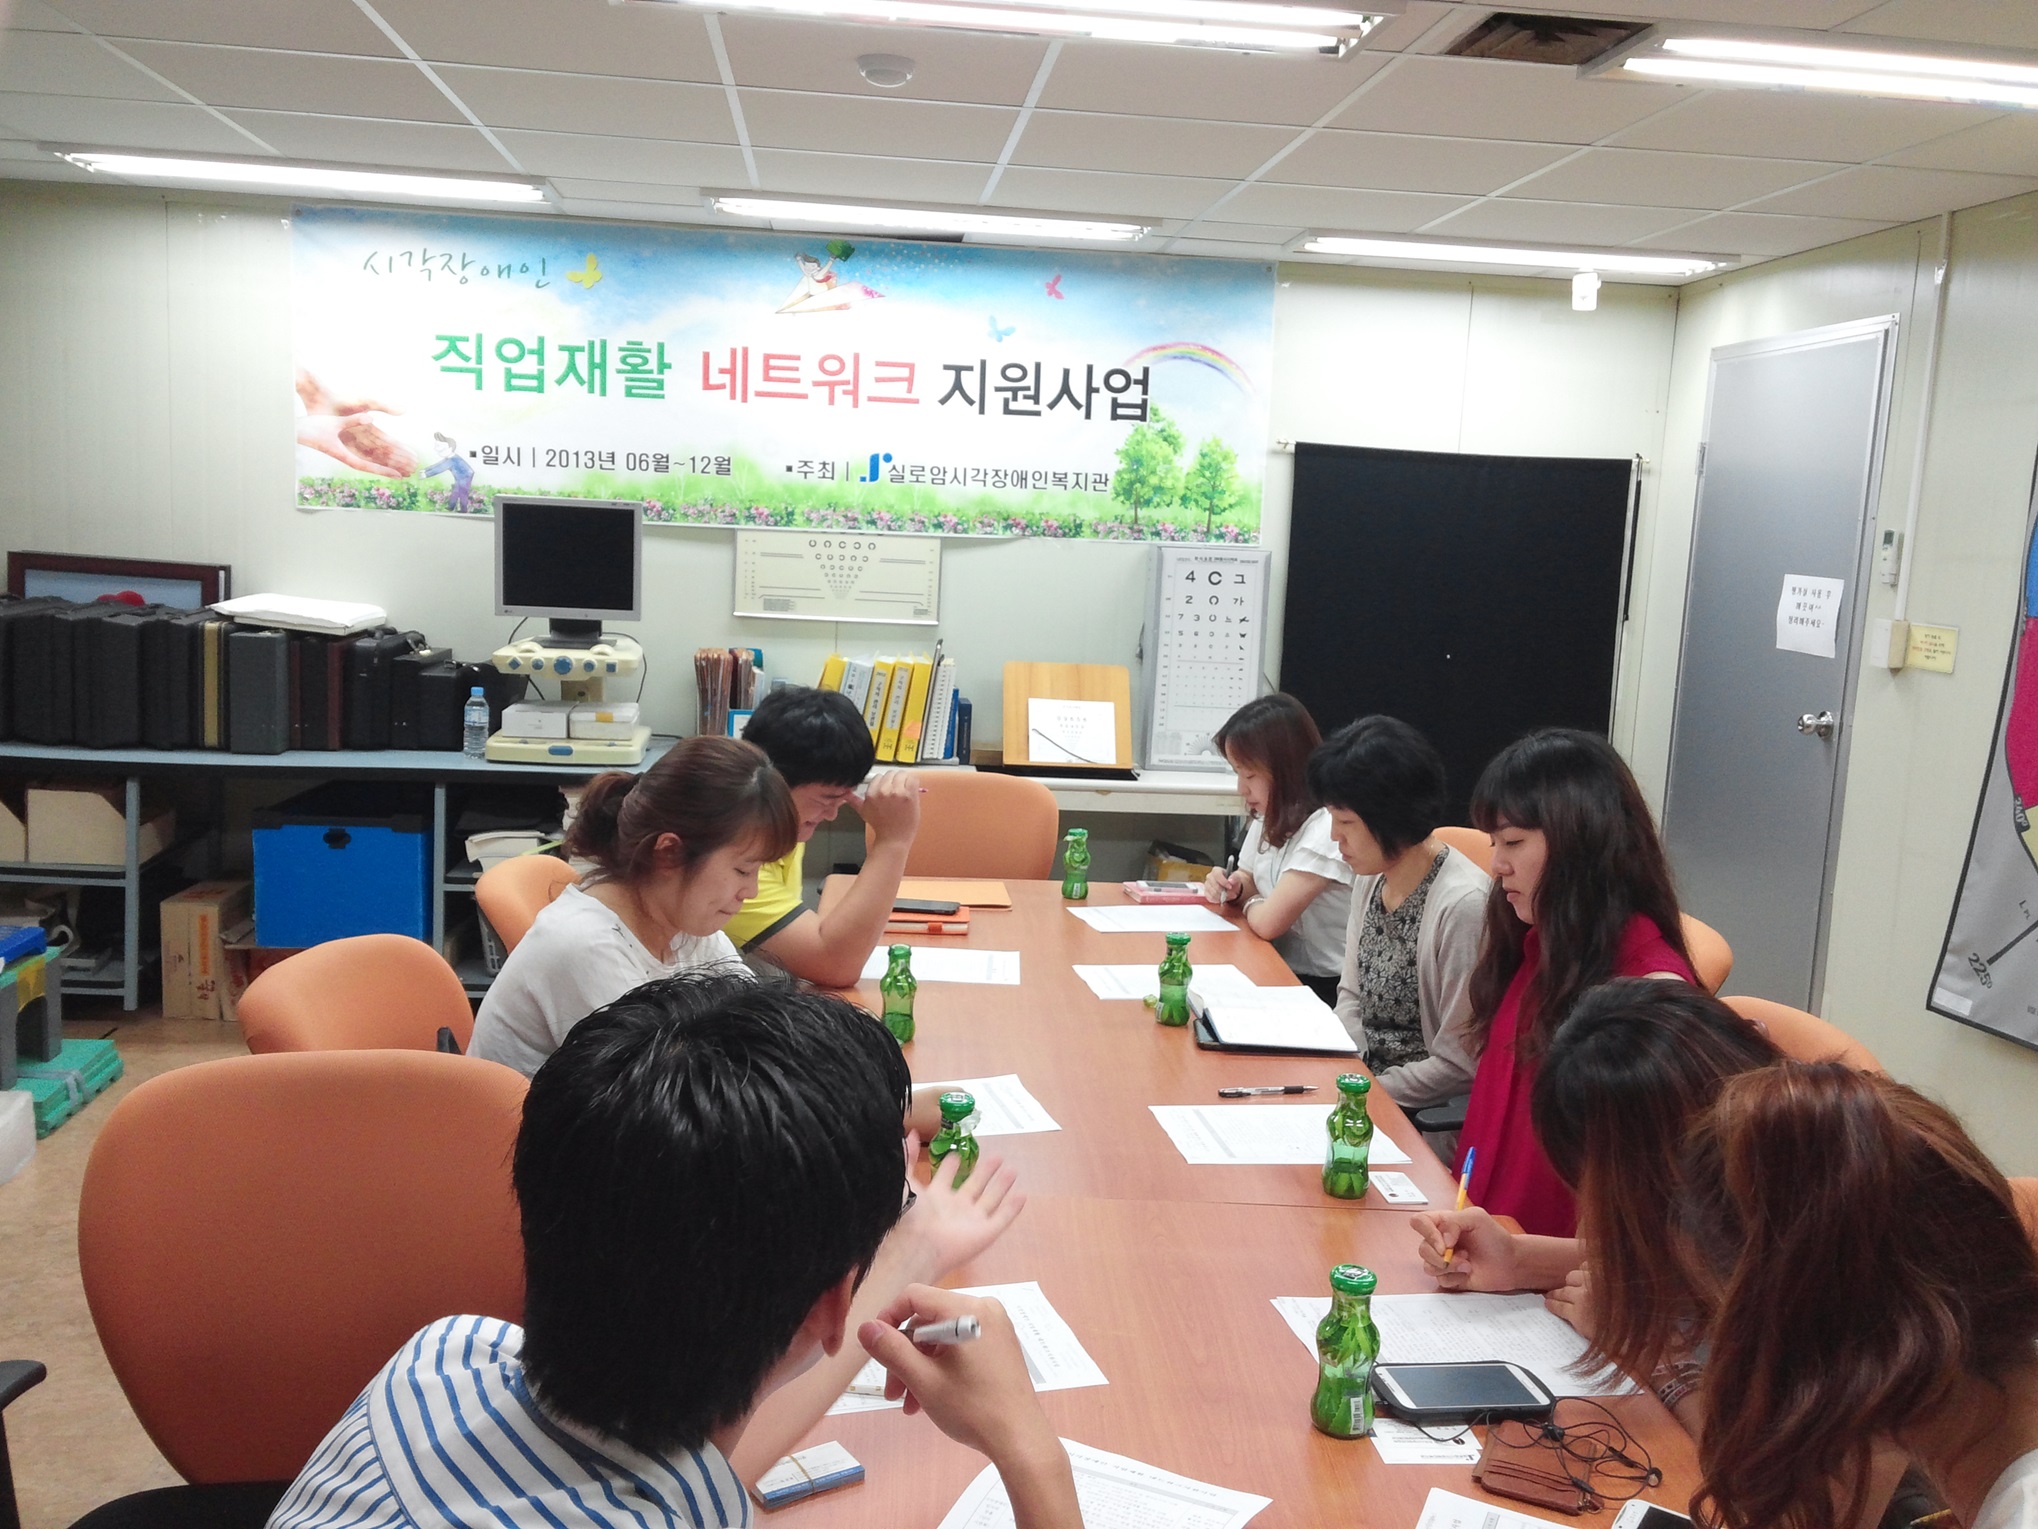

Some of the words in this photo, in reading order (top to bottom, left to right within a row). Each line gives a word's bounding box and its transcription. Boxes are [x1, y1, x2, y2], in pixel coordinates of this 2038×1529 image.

[363, 247, 551, 289] 시각장애인
[431, 333, 672, 400] 직업재활
[702, 346, 920, 409] 네트워크
[938, 358, 1151, 422] 지원사업
[481, 445, 521, 468] 일시
[545, 449, 616, 472] 2013년
[796, 460, 836, 481] 주최
[887, 463, 1110, 493] 실로암시각장애인복지관
[1185, 570, 1196, 583] 4
[1185, 595, 1193, 604] 2
